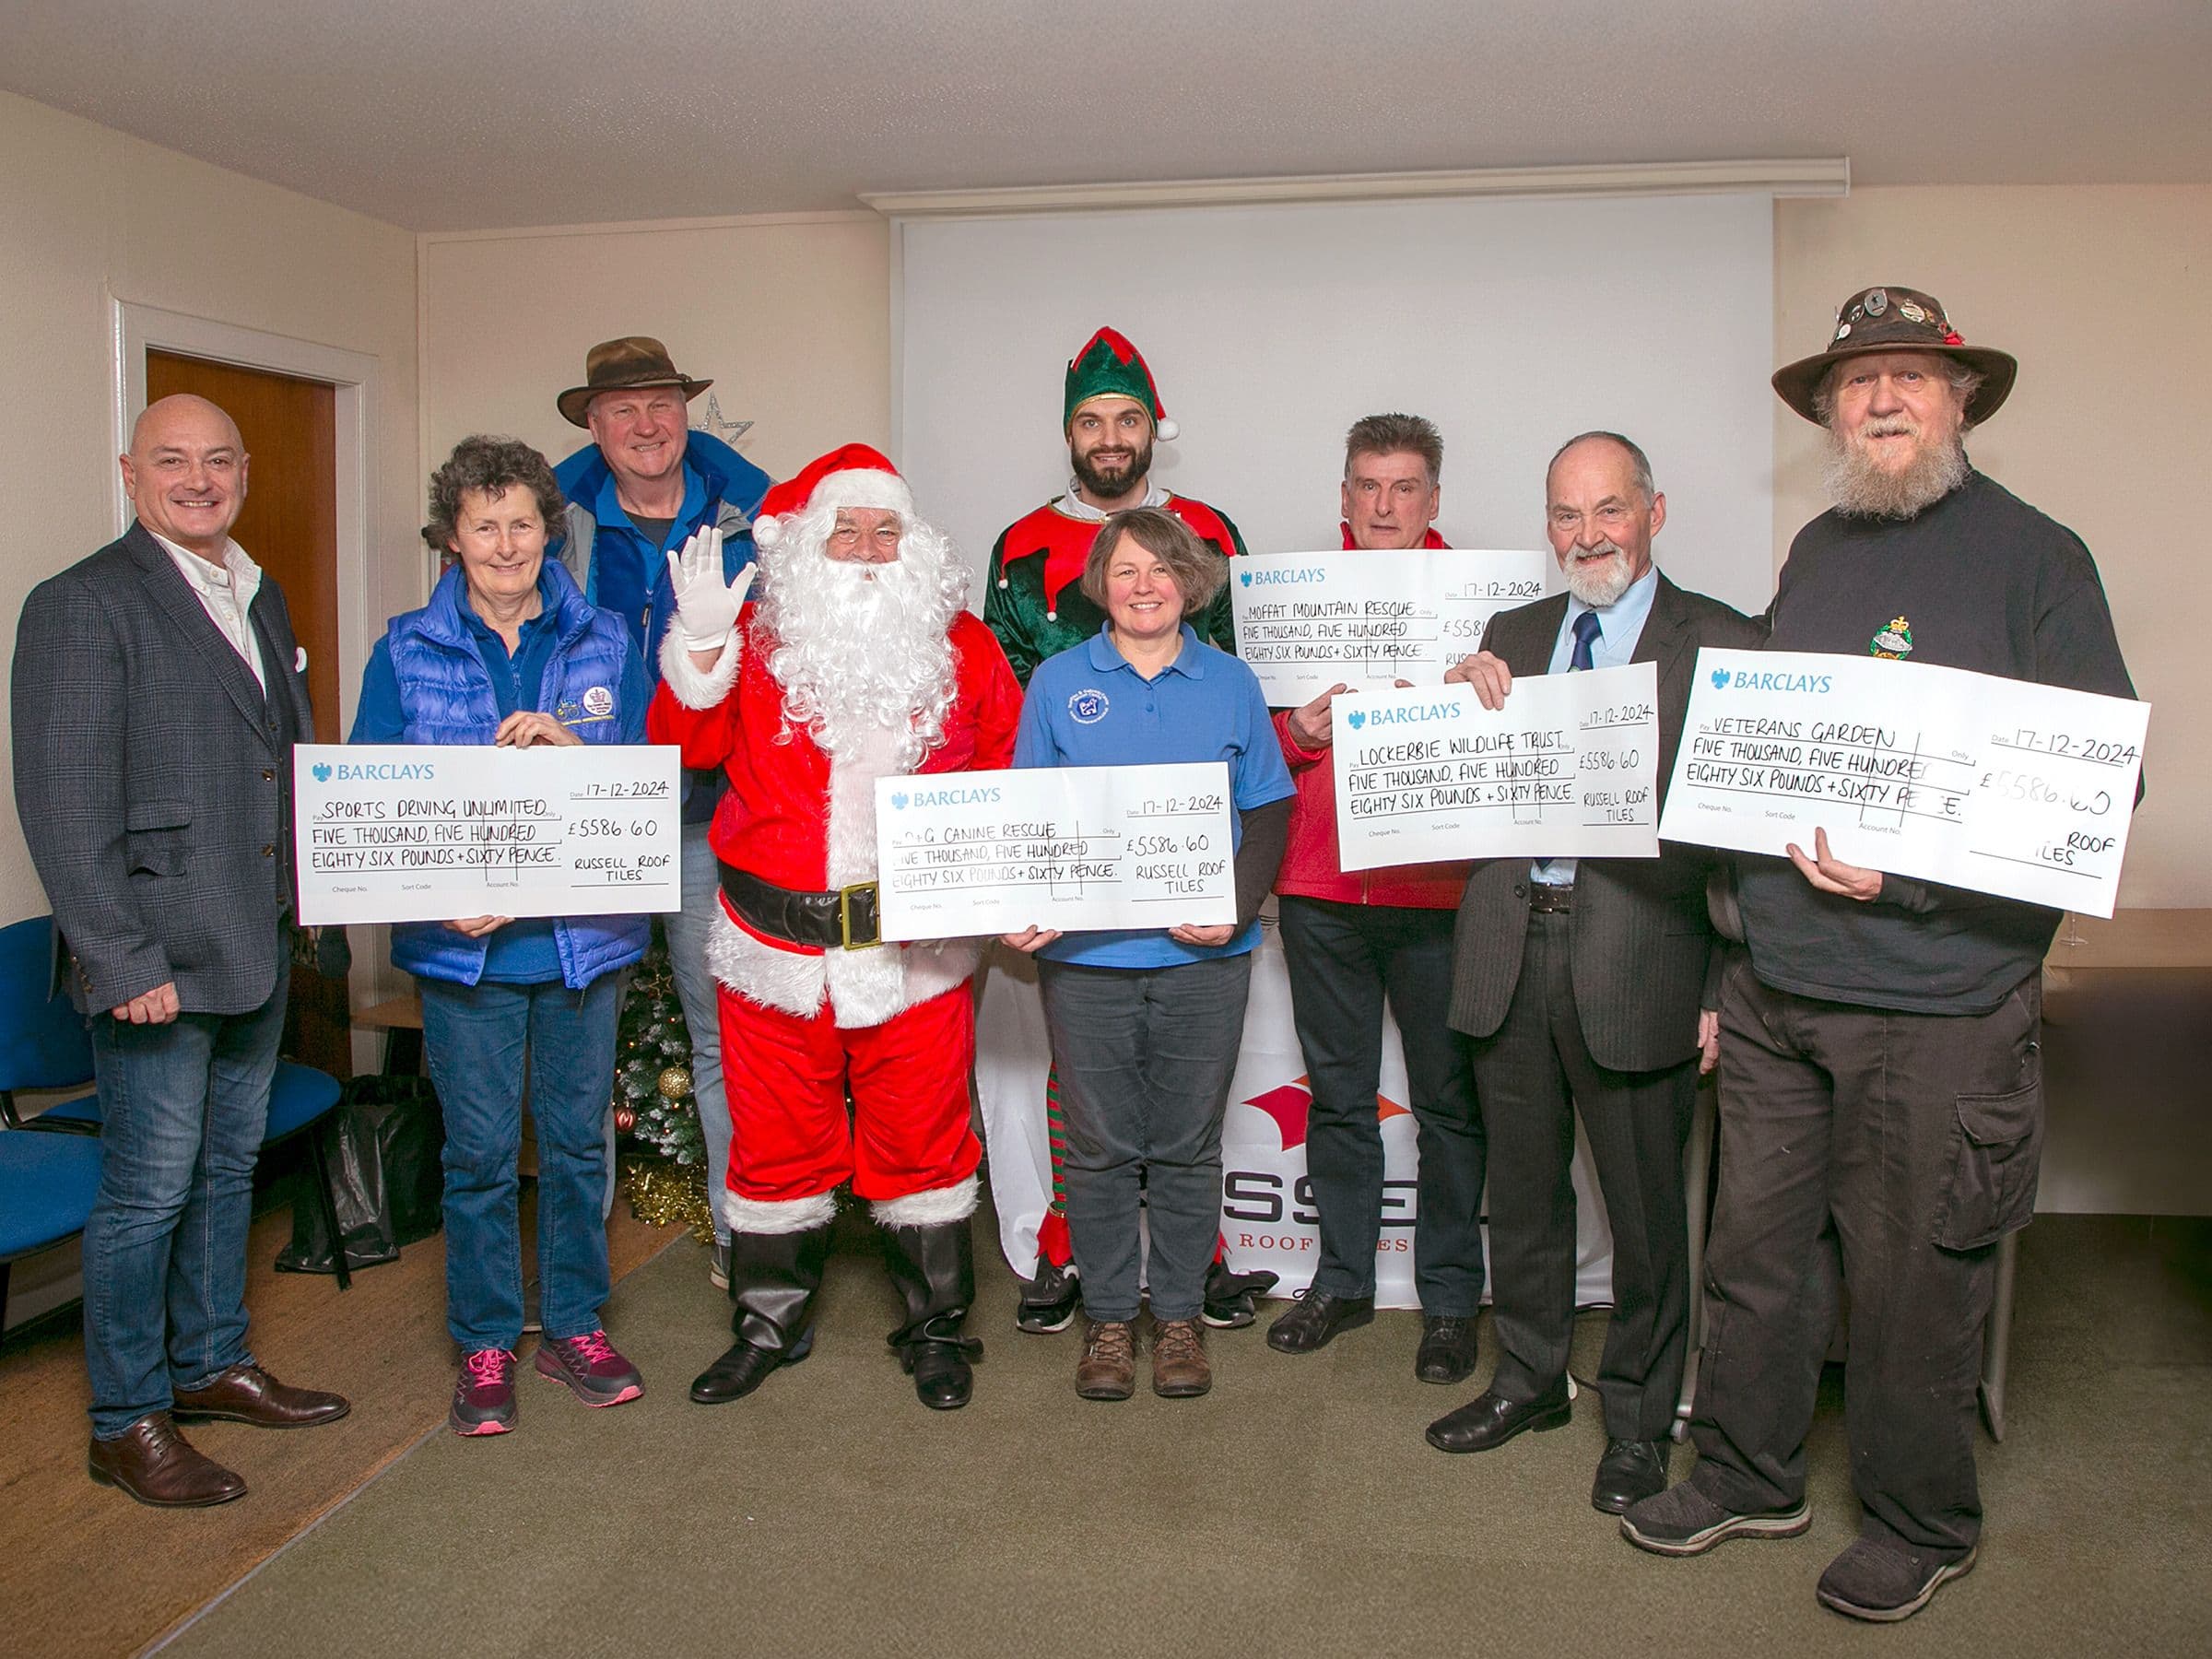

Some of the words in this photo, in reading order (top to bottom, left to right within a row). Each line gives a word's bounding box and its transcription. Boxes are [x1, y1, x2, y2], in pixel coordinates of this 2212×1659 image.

[1255, 568, 1325, 585] BARCLAYS
[1465, 581, 1542, 597] 17-12-2024
[1248, 604, 1288, 620] MOFFAT
[1293, 600, 1358, 618] MOUNTAIN
[1365, 600, 1417, 618] RESCUE
[1243, 625, 1259, 640] FIVE
[1263, 623, 1312, 640] THOUSAND,
[1318, 622, 1343, 638] FIVE
[1348, 621, 1407, 638] HUNDRED
[1245, 645, 1273, 661] EIGHTY
[1276, 645, 1291, 660] SIX
[1295, 644, 1334, 660] POUNDS
[1334, 647, 1340, 657] +
[1343, 643, 1380, 659] SIXTY
[1735, 671, 1832, 693] BARCLAYS
[1371, 702, 1461, 725] BARCLAYS
[1590, 703, 1654, 724] 17-12-2024
[1713, 717, 1802, 737] VETERANS
[1811, 722, 1896, 747] GARDEN
[1359, 739, 1441, 766] LOCKERBIE
[1449, 733, 1518, 756] WILDLIFE
[1521, 730, 1564, 748] TRUST
[1693, 736, 1725, 757] FIVE
[1730, 741, 1802, 766] THOUSAND,
[1809, 747, 1844, 770] FIVE
[1951, 749, 1970, 760] Only
[2016, 728, 2141, 765] 17-12-2024
[337, 763, 434, 781] BARCLAYS
[1348, 772, 1378, 793] FIVE
[1459, 761, 1488, 779] FIVE
[1496, 759, 1559, 778] HUNDRED
[586, 781, 670, 797] 17-12-2024
[913, 787, 1001, 807] BARCLAYS
[1583, 791, 1619, 807] RUSSELL
[1625, 786, 1650, 806] ROOF
[1687, 762, 1737, 785] EIGHTY
[1739, 767, 1765, 788] SIX
[1770, 768, 1825, 794] POUNDS
[1827, 781, 1836, 793] +
[1838, 778, 1890, 804] SIXTY
[1896, 786, 1961, 815] PEE.
[322, 801, 386, 819] SPORTS
[397, 799, 456, 818] DRIVING
[464, 798, 547, 817] UNLIMITED
[1143, 794, 1224, 815] 17-12-2024
[1349, 794, 1397, 815] EIGHTY
[1401, 791, 1424, 809] SIX
[1430, 787, 1480, 807] POUNDS
[1487, 793, 1495, 802] +
[1497, 784, 1530, 802] SIXTY
[1606, 807, 1634, 823] TILES
[1765, 809, 1778, 819] Sort
[1779, 811, 1796, 820] Code
[312, 828, 347, 845] FIVE
[353, 826, 429, 844] THOUSAND,
[435, 824, 464, 842] FIVE
[471, 823, 535, 842] HUNDRED
[568, 818, 658, 838] £5586.60
[944, 825, 996, 844] CANINE
[1003, 822, 1057, 839] RESCUE
[1858, 821, 1887, 834] Account
[897, 850, 919, 865] IVE
[924, 845, 991, 865] THOUSAND,
[995, 843, 1022, 859] FIVE
[1027, 840, 1088, 858] HUNDRED
[1126, 833, 1210, 857] £5586.60
[2066, 831, 2116, 853] ROOF
[312, 850, 366, 869] EIGHTY
[369, 850, 394, 866] SIX
[402, 848, 454, 866] POUNDS
[457, 853, 465, 863] +
[465, 847, 505, 865] SIXTY
[574, 857, 627, 870] RUSSELL
[638, 854, 671, 868] ROOF
[606, 869, 643, 882] TILES
[892, 871, 937, 888] EIGHTY
[943, 869, 965, 884] SIX
[970, 865, 1017, 883] POUNDS
[1018, 870, 1025, 878] +
[1028, 865, 1064, 880] SIXTY
[1135, 863, 1189, 880] RUSSELL
[1198, 859, 1227, 877] ROOF
[1164, 878, 1205, 894] TILES
[1239, 1233, 1313, 1252] ROOF
